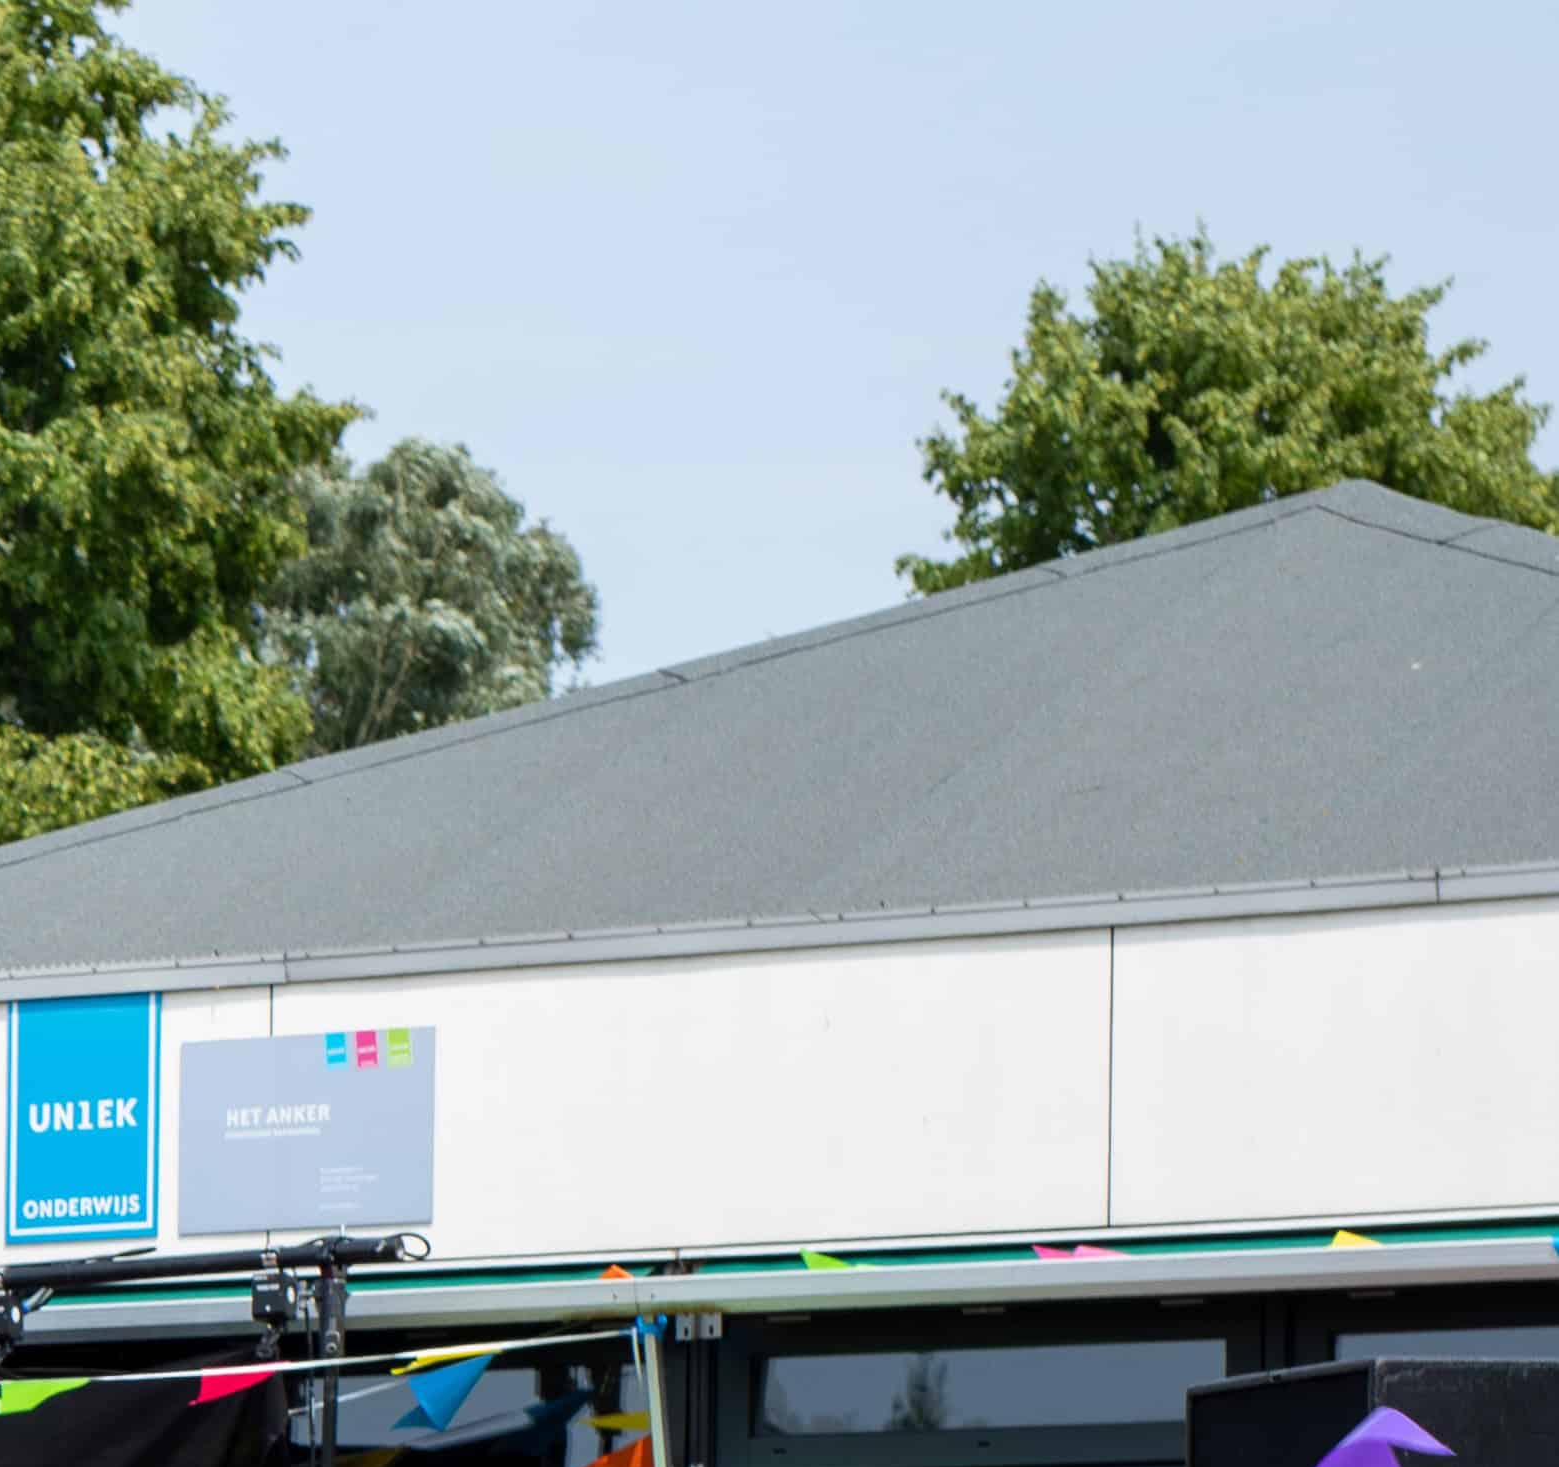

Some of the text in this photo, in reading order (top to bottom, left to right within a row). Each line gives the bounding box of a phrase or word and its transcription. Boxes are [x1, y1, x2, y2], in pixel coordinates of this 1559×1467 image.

[29, 1098, 138, 1133] UN1EK
[226, 1104, 331, 1127] HET ANKER
[23, 1194, 140, 1220] ONDERWIJS
